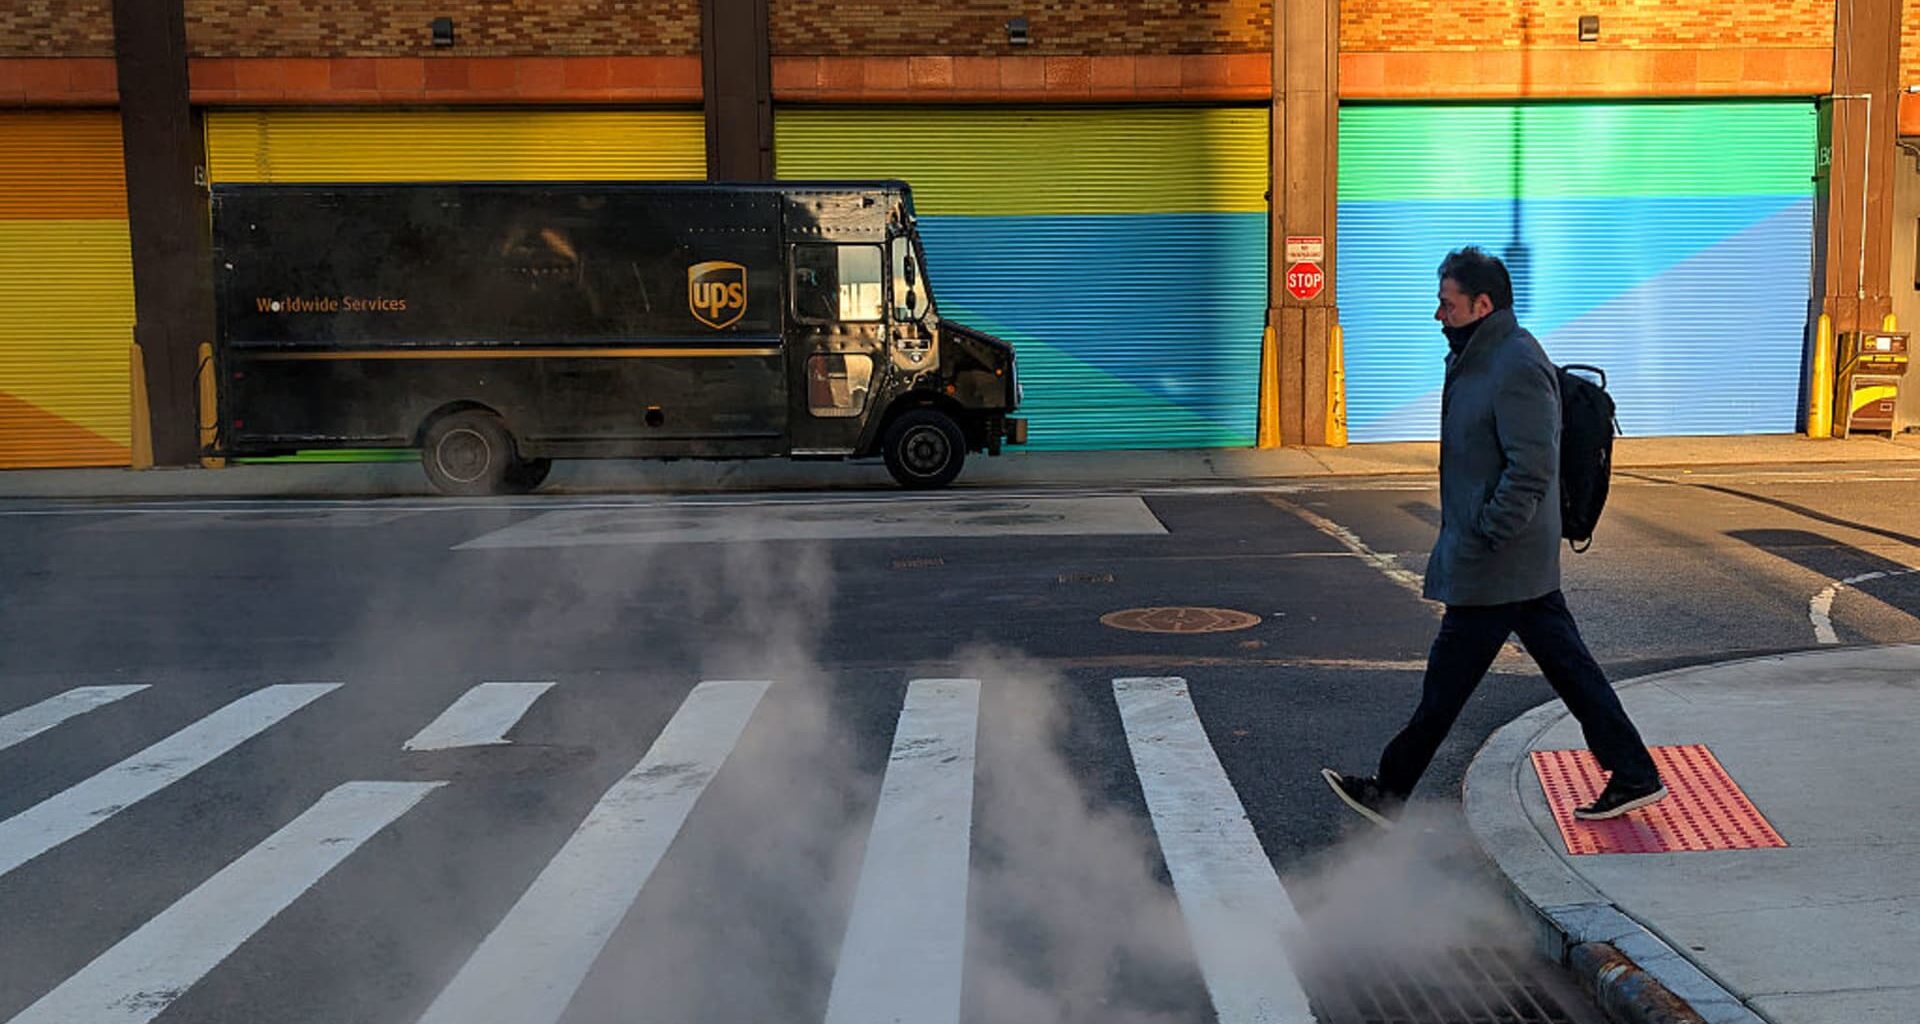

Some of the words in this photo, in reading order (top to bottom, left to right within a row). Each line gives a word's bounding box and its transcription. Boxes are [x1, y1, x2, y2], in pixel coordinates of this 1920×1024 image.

[1289, 273, 1321, 288] STOP
[256, 296, 338, 312] Worldwide
[343, 296, 407, 311] Services
[693, 281, 743, 319] ups
